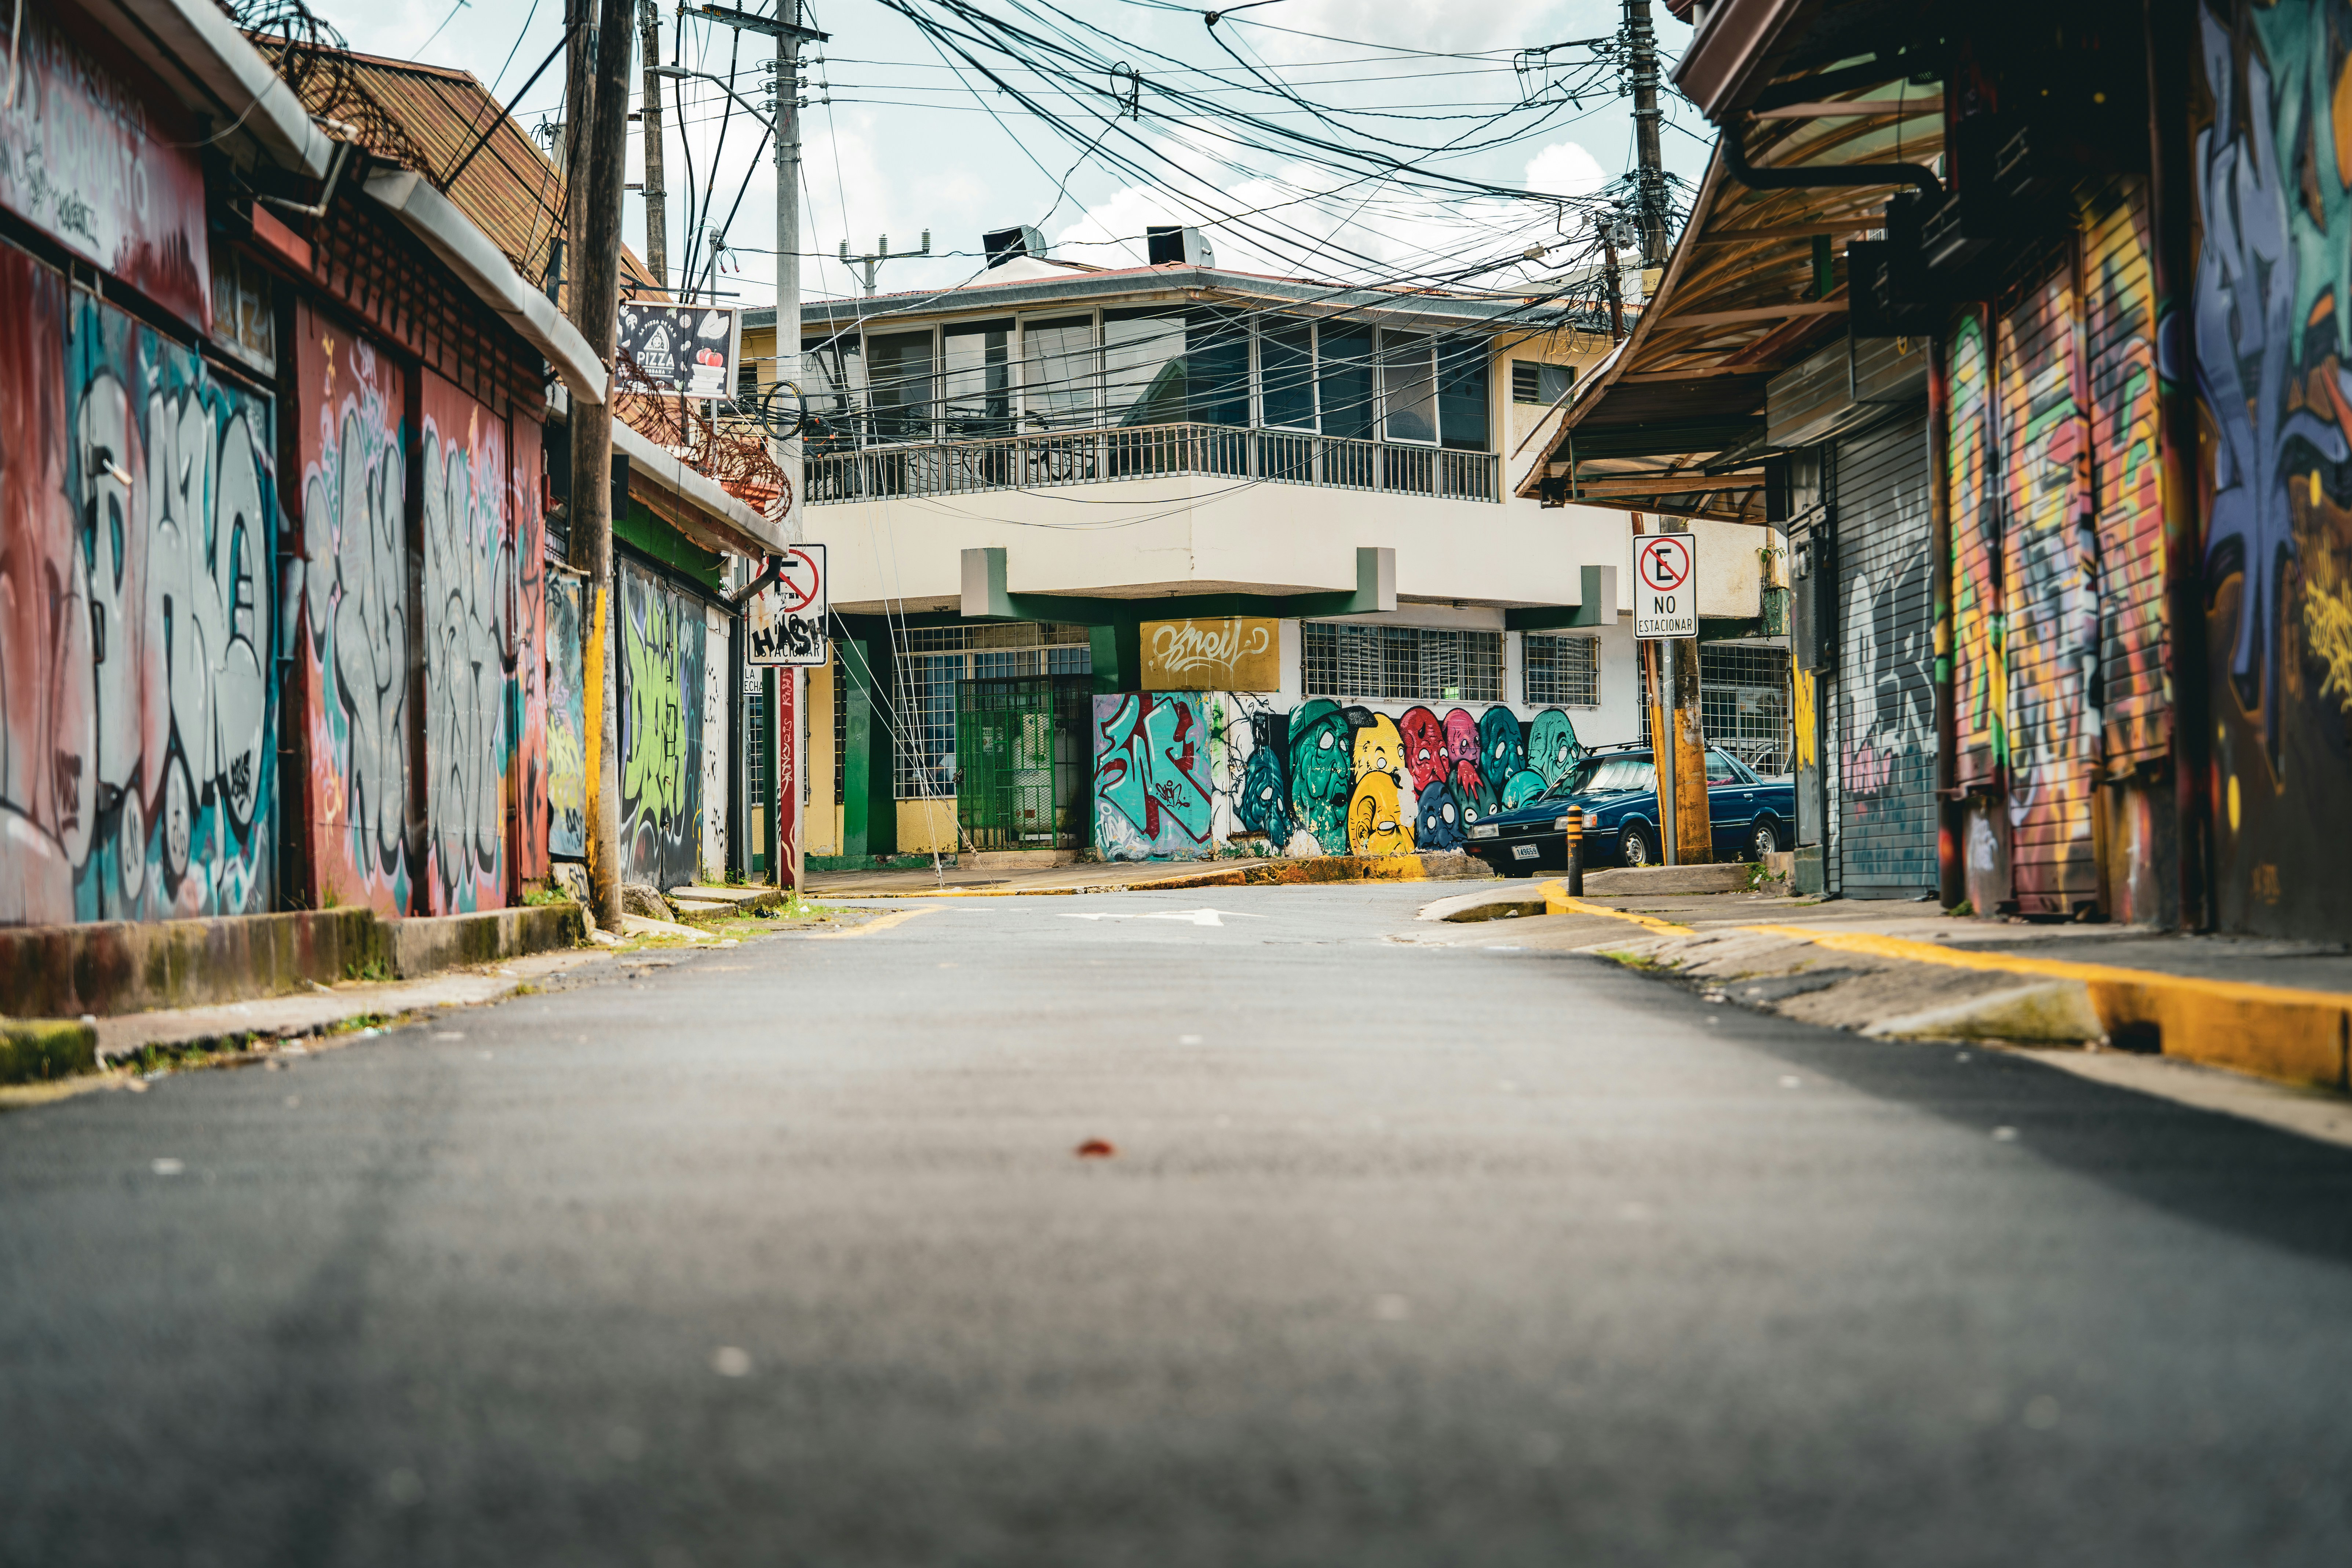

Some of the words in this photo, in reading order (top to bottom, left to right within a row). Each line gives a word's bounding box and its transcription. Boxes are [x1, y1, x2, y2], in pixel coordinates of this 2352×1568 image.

[645, 319, 659, 328] PIZZA
[637, 351, 675, 367] PIZZA
[1655, 595, 1676, 614] NO
[1639, 619, 1692, 632] ESTACIONAR
[745, 668, 755, 679] LA
[1517, 848, 1537, 856] 149659
